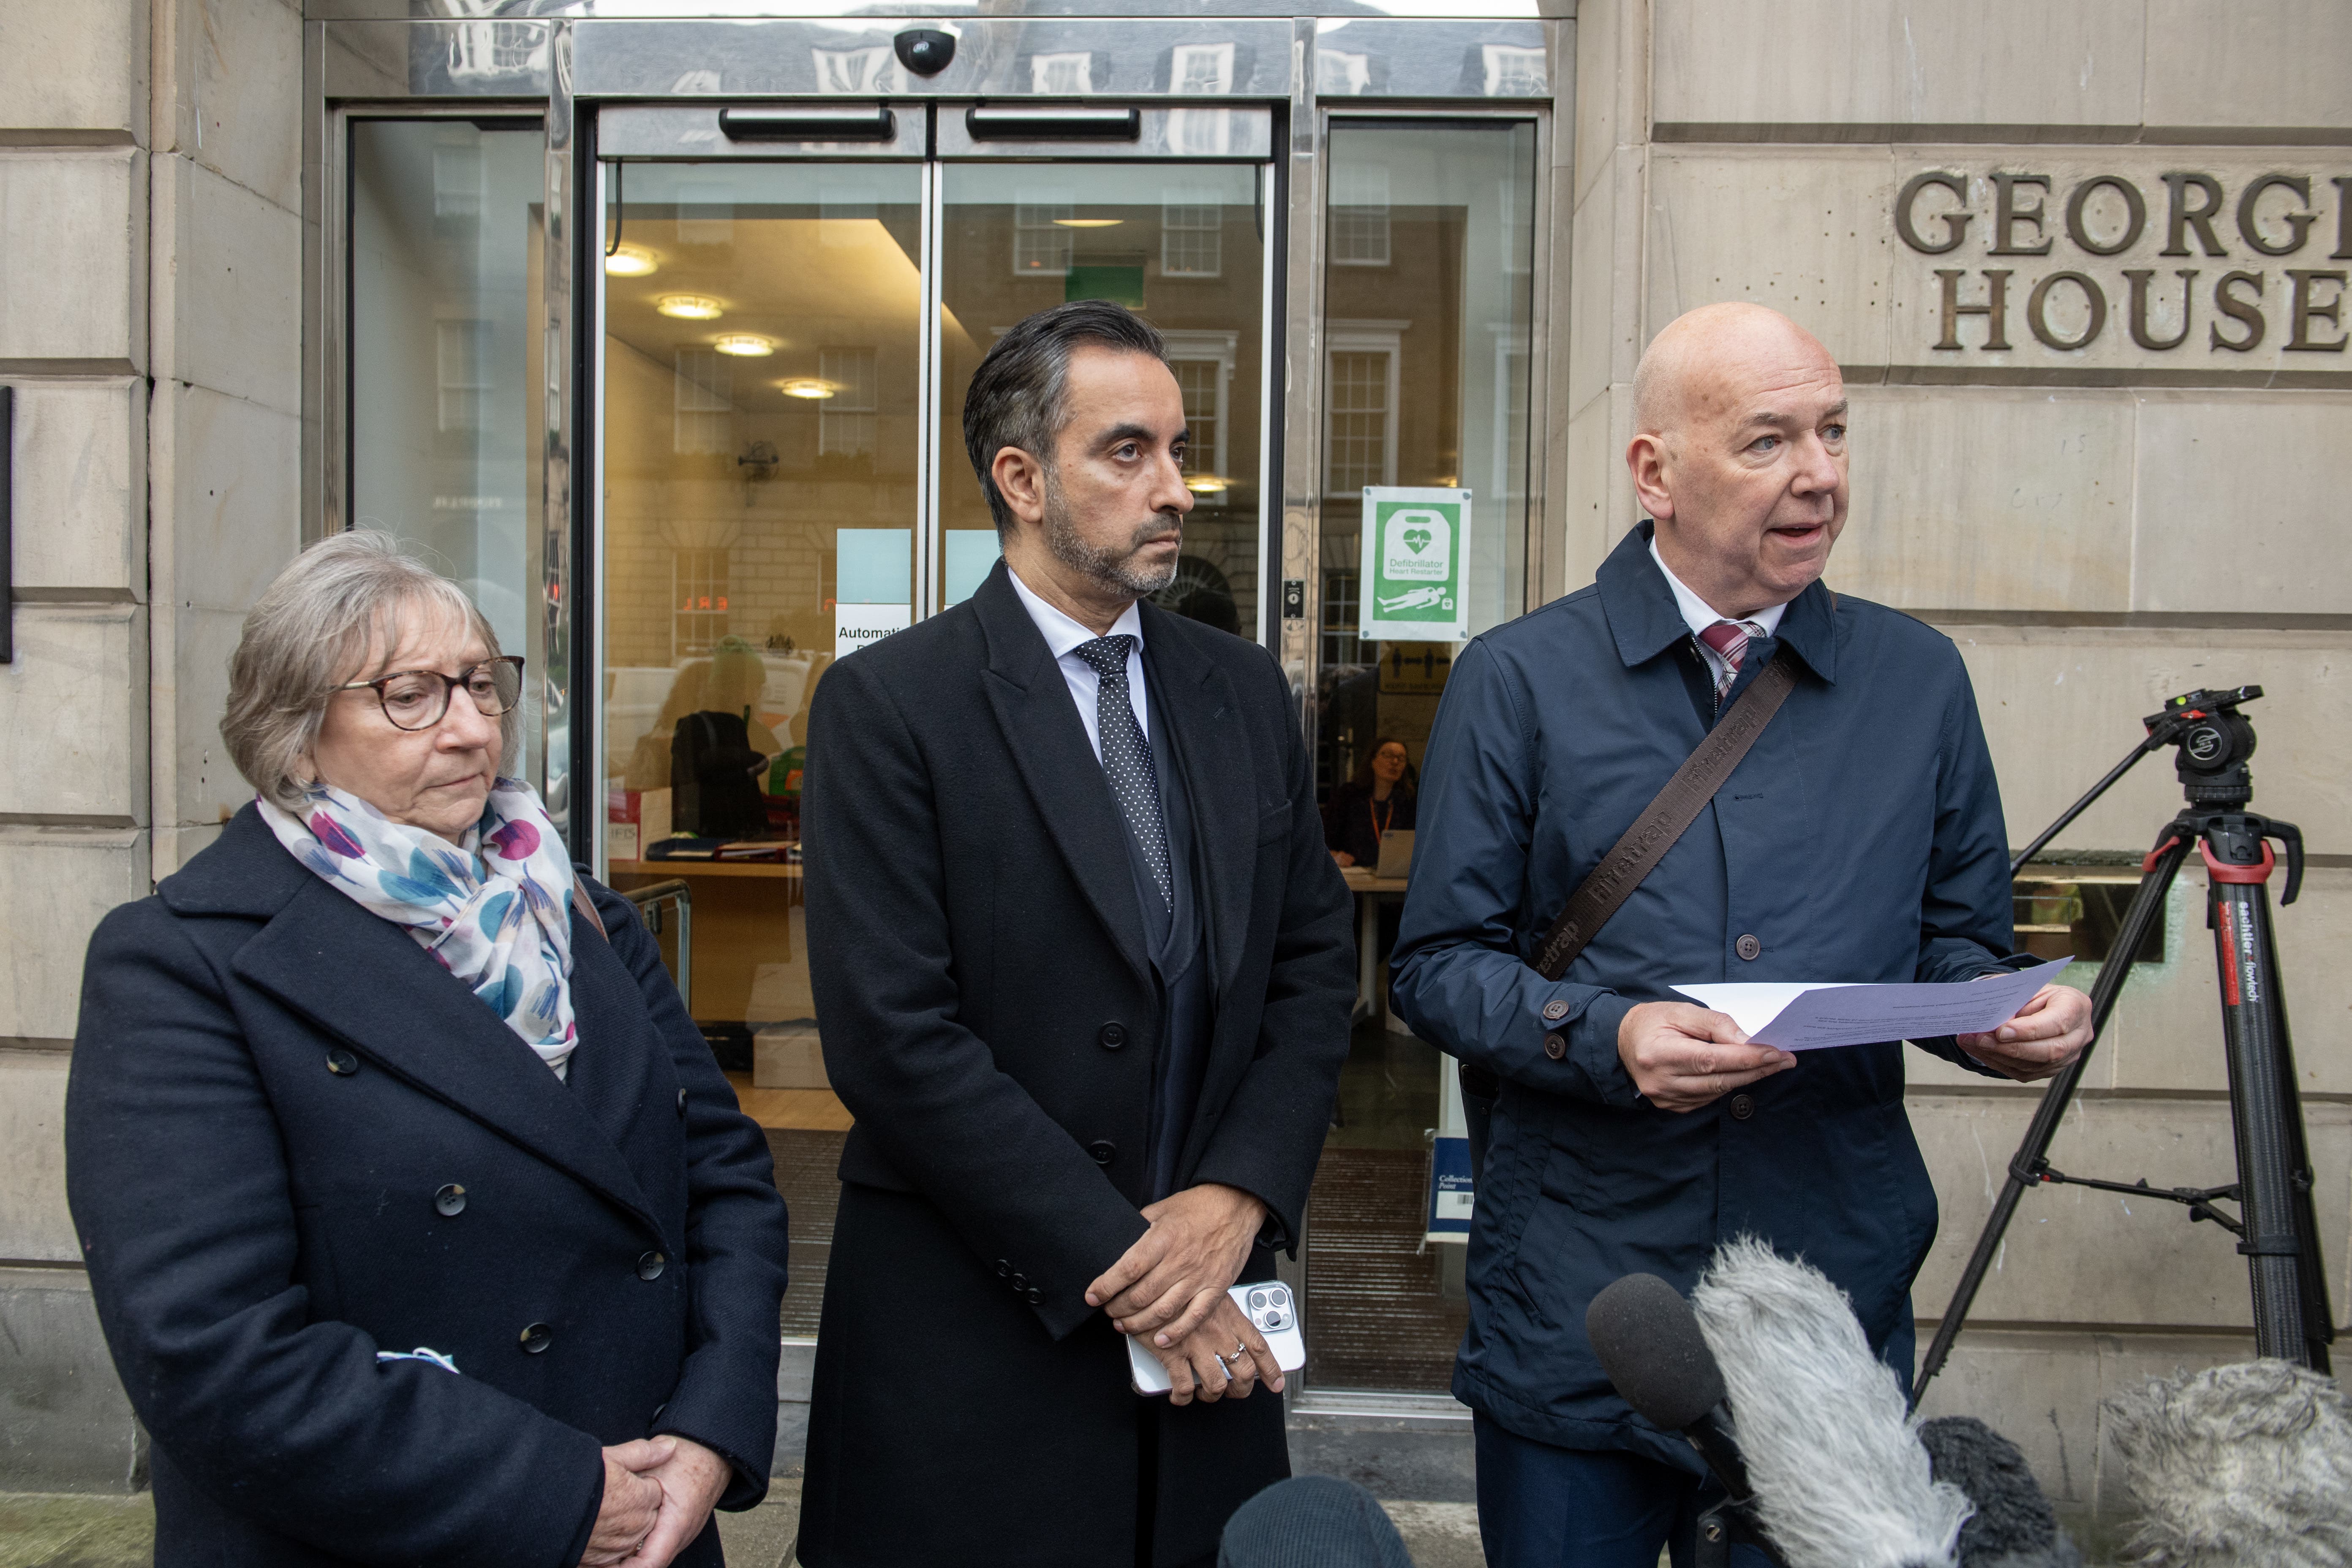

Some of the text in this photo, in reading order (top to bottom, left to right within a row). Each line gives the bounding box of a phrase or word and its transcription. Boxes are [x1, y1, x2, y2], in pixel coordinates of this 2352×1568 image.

[1933, 269, 2349, 351] HOUSE
[1390, 558, 1443, 568] Defibrillator
[1681, 704, 1757, 792] Firetrap
[1587, 811, 1671, 904] Firetrap
[2239, 901, 2259, 1002] sachtler flowtech
